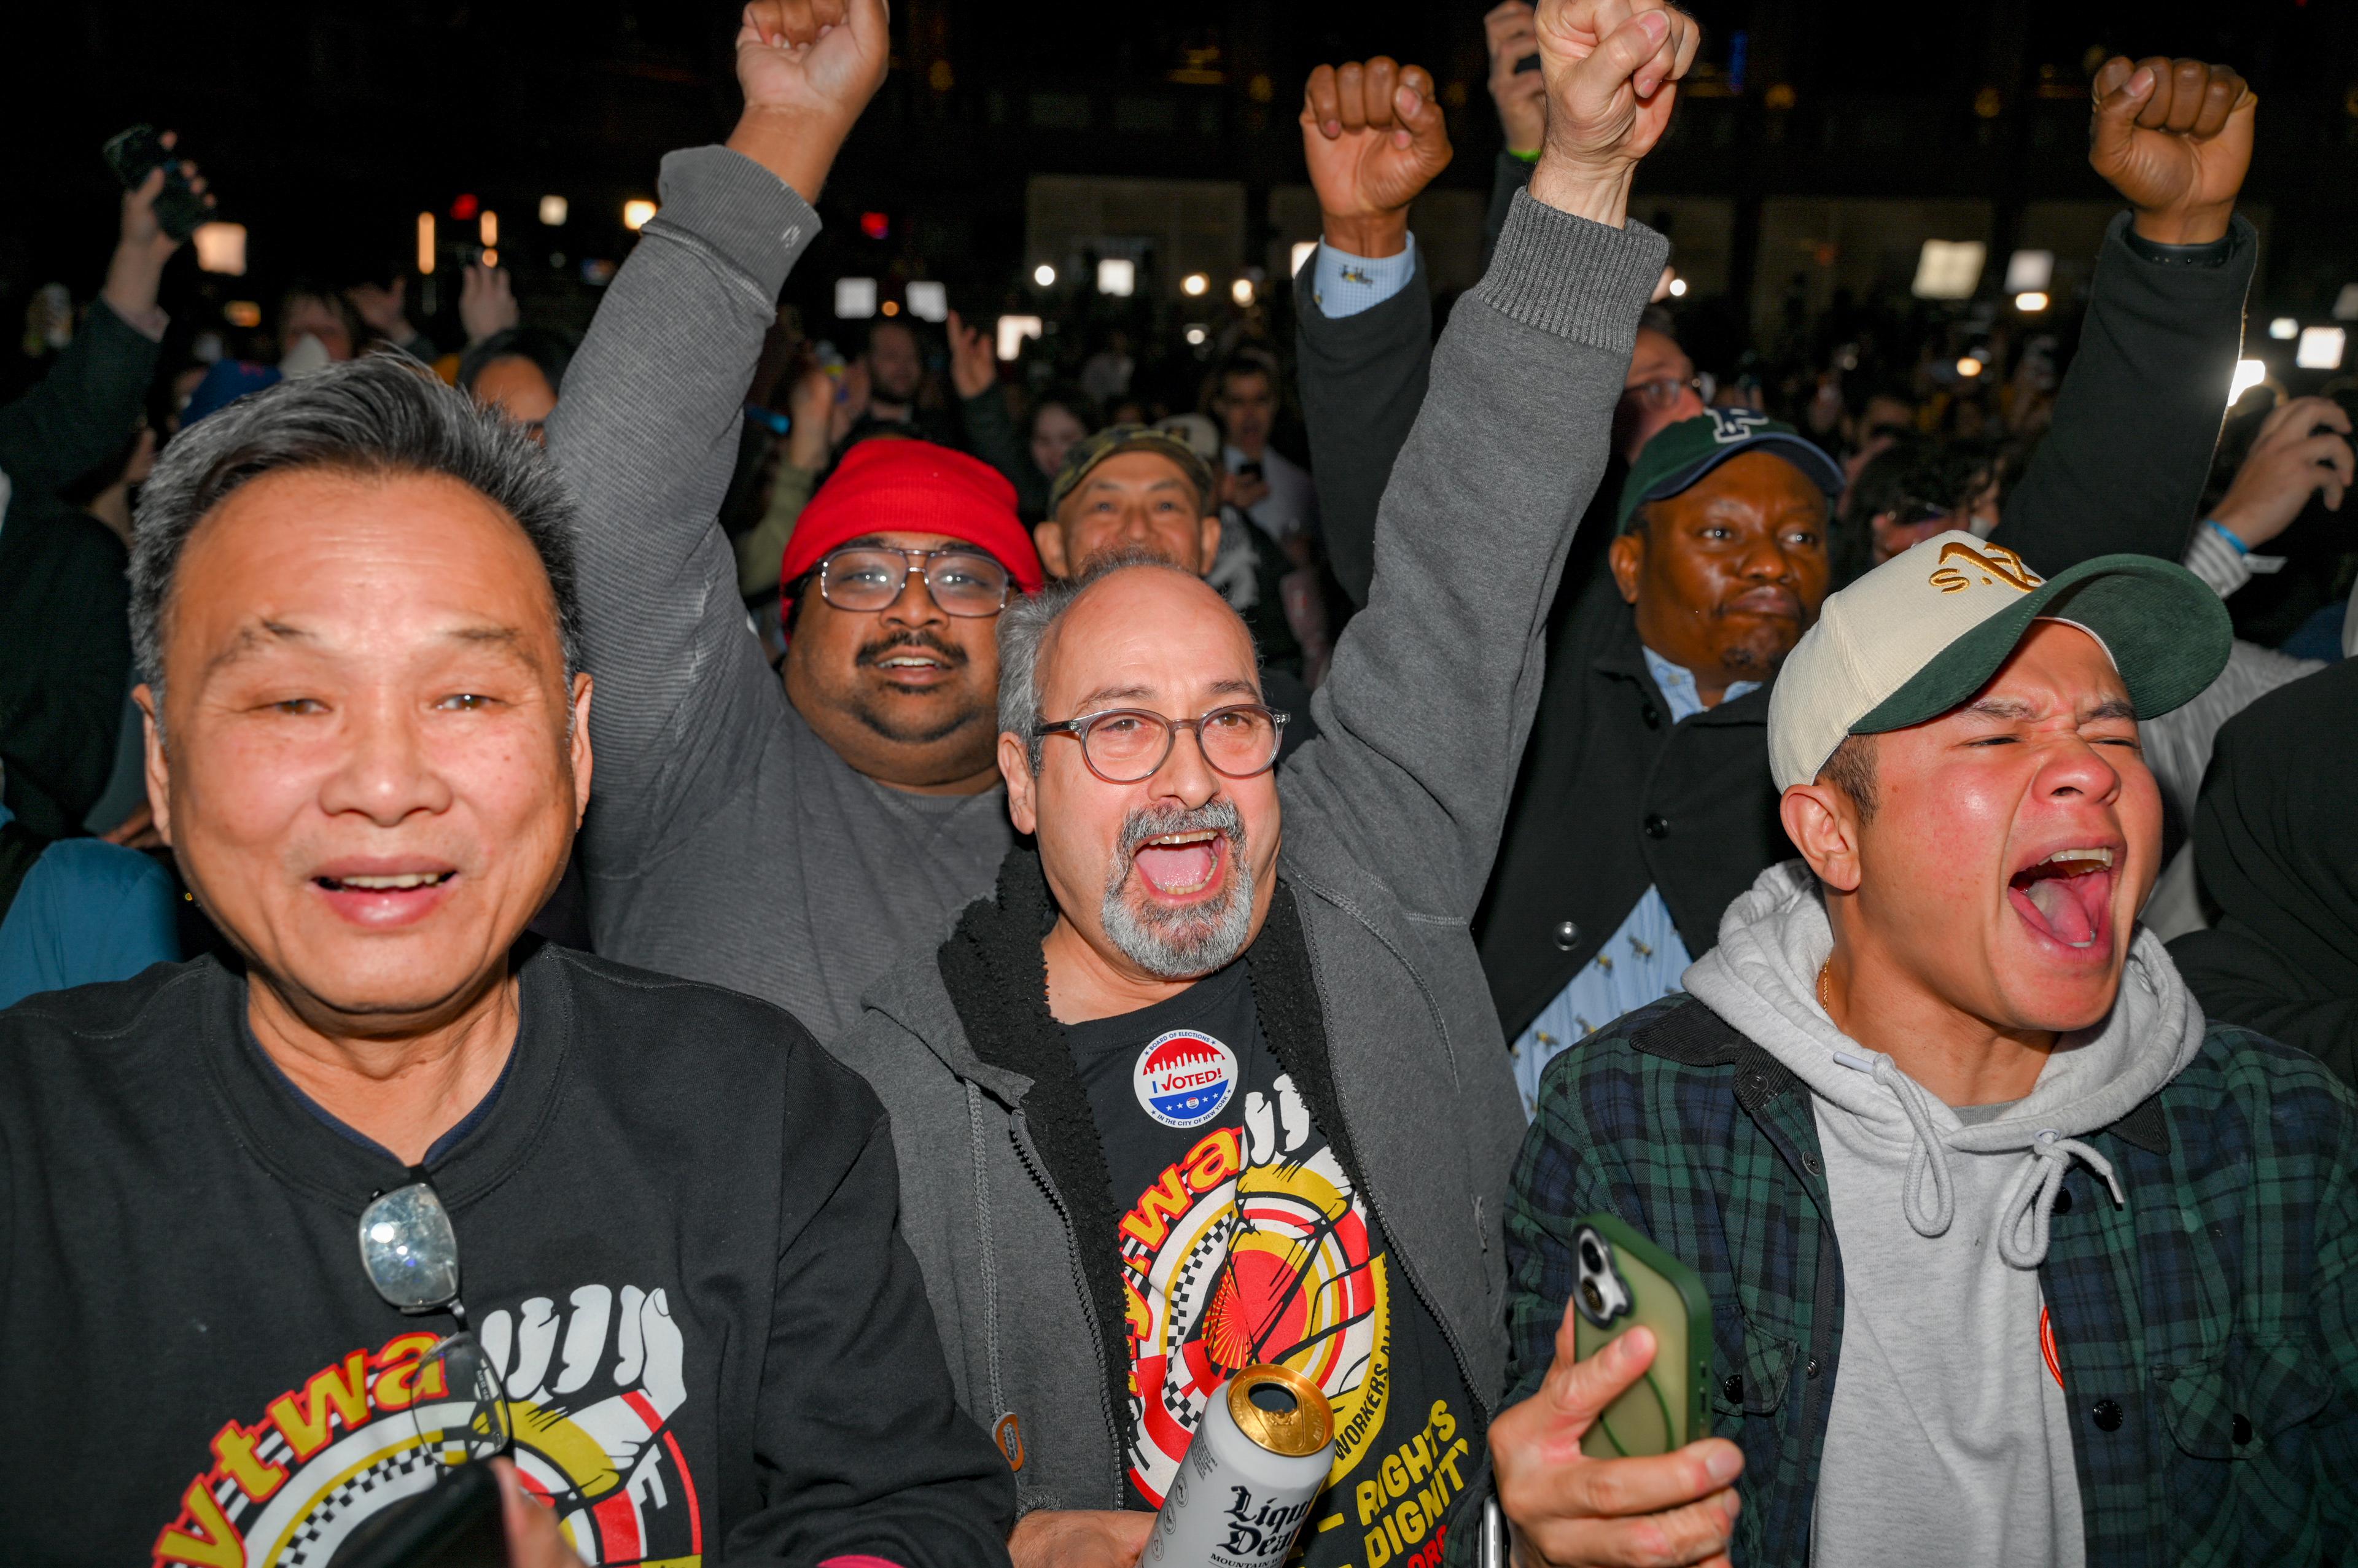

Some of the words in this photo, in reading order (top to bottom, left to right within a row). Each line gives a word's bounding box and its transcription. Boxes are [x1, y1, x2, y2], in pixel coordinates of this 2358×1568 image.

[1149, 1036, 1168, 1050] BOARD
[1179, 1031, 1210, 1042] ELECTIONS
[1152, 1081, 1158, 1093] I
[1161, 1068, 1222, 1091] VOTED!
[1204, 1110, 1215, 1120] NEW
[1216, 1096, 1228, 1111] YORK
[1336, 1363, 1388, 1461] WORKERS
[1223, 1485, 1309, 1535] Liqu
[1216, 1521, 1294, 1556] Dea
